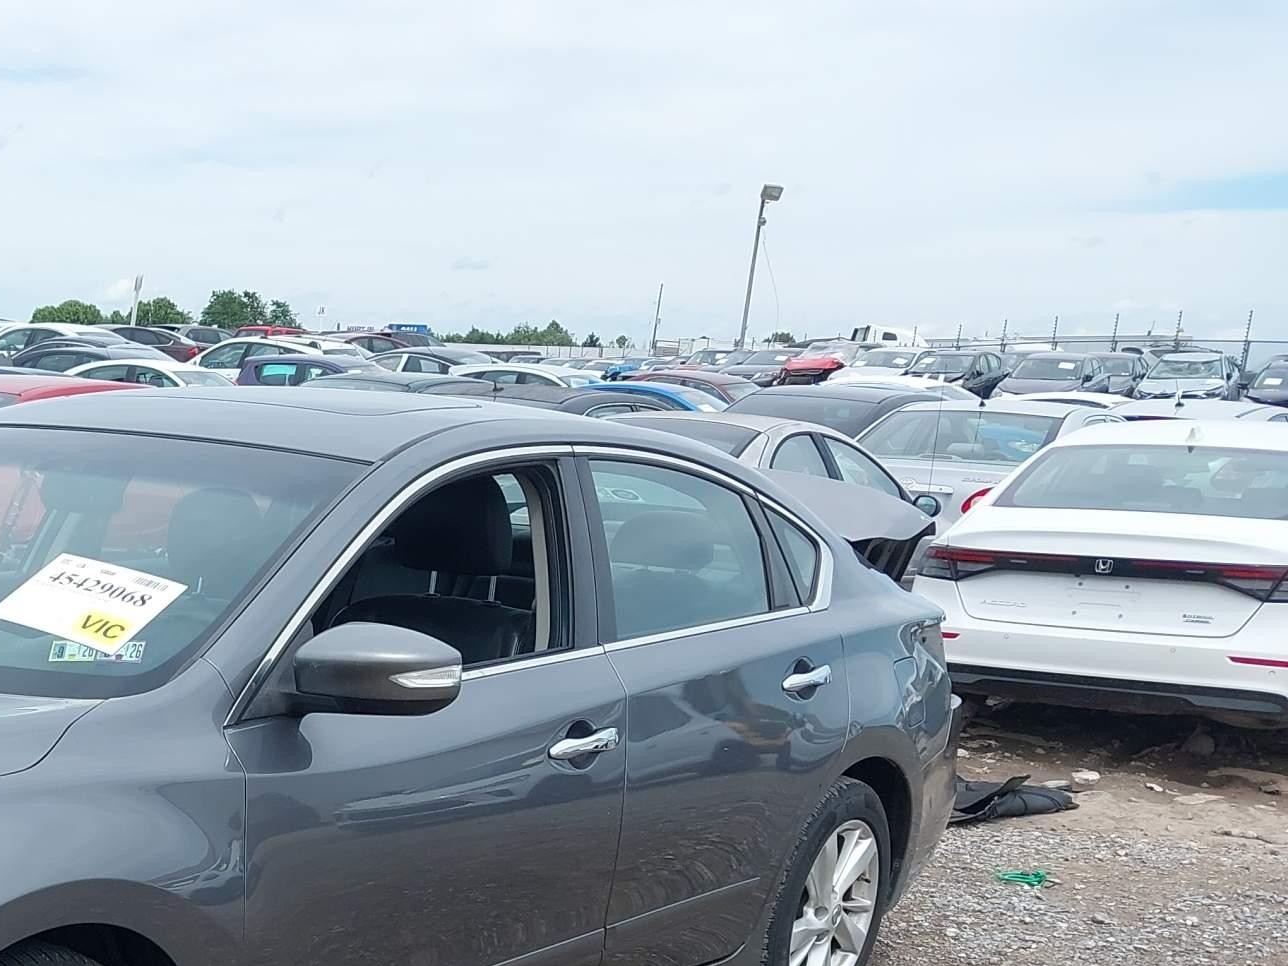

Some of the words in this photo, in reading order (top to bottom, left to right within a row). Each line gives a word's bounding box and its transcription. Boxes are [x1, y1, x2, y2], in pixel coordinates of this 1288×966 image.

[50, 572, 152, 607] 45429068
[81, 615, 126, 639] VIC
[129, 643, 143, 659] 26
